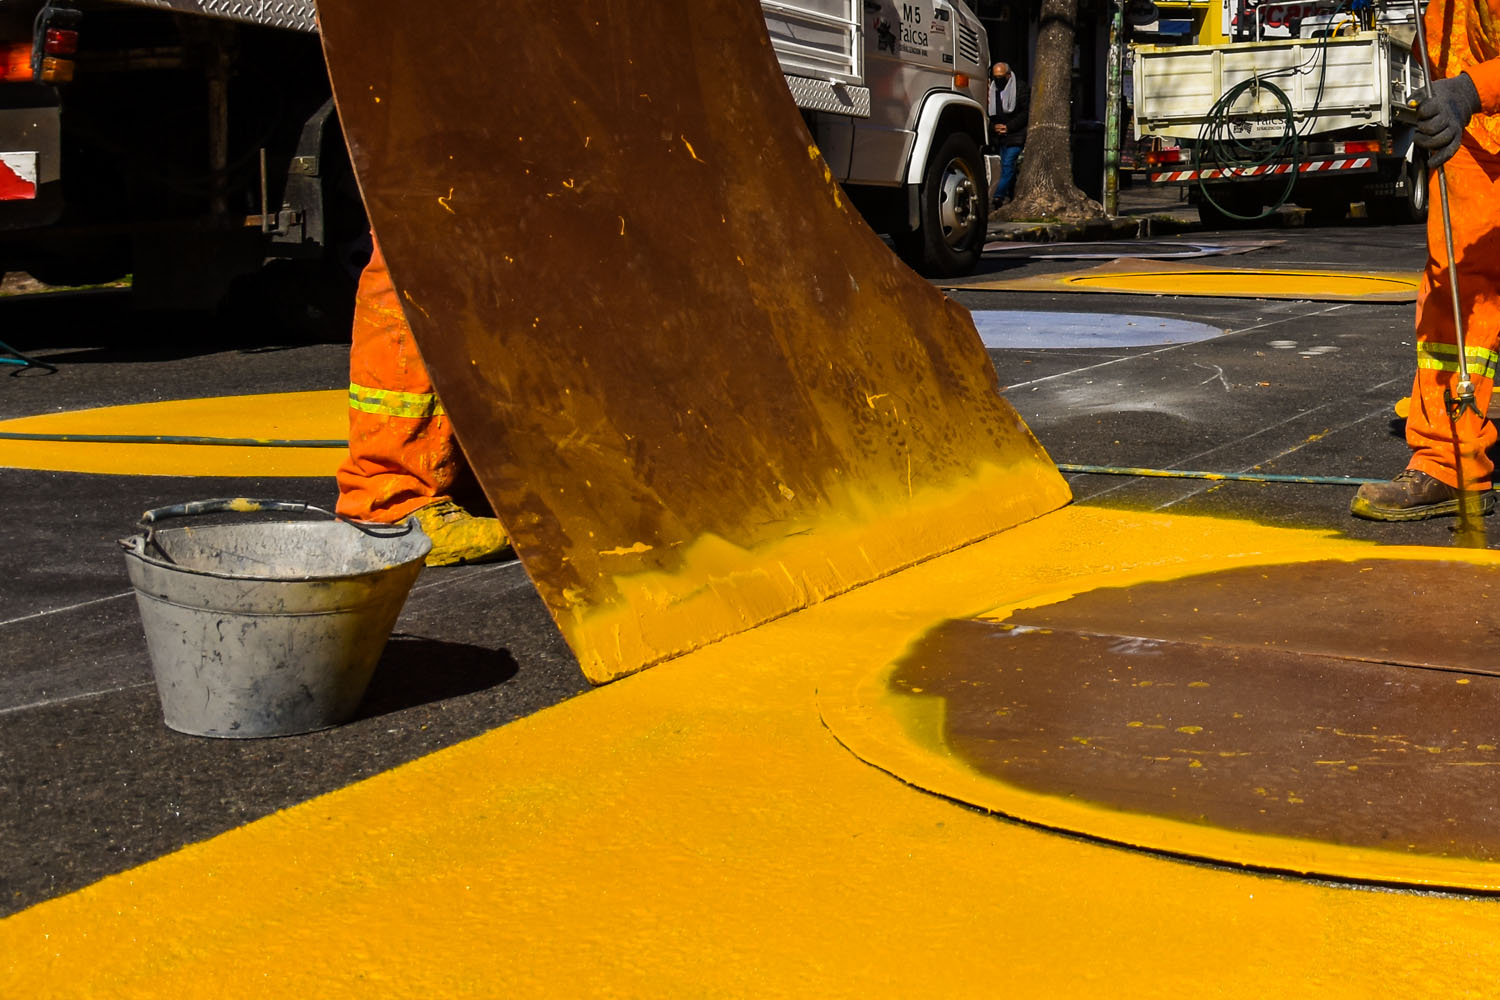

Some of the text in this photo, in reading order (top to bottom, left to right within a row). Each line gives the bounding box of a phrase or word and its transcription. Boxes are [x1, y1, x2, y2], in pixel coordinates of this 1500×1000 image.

[904, 3, 913, 23] M
[915, 6, 921, 24] 5
[900, 22, 928, 47] Faicsa
